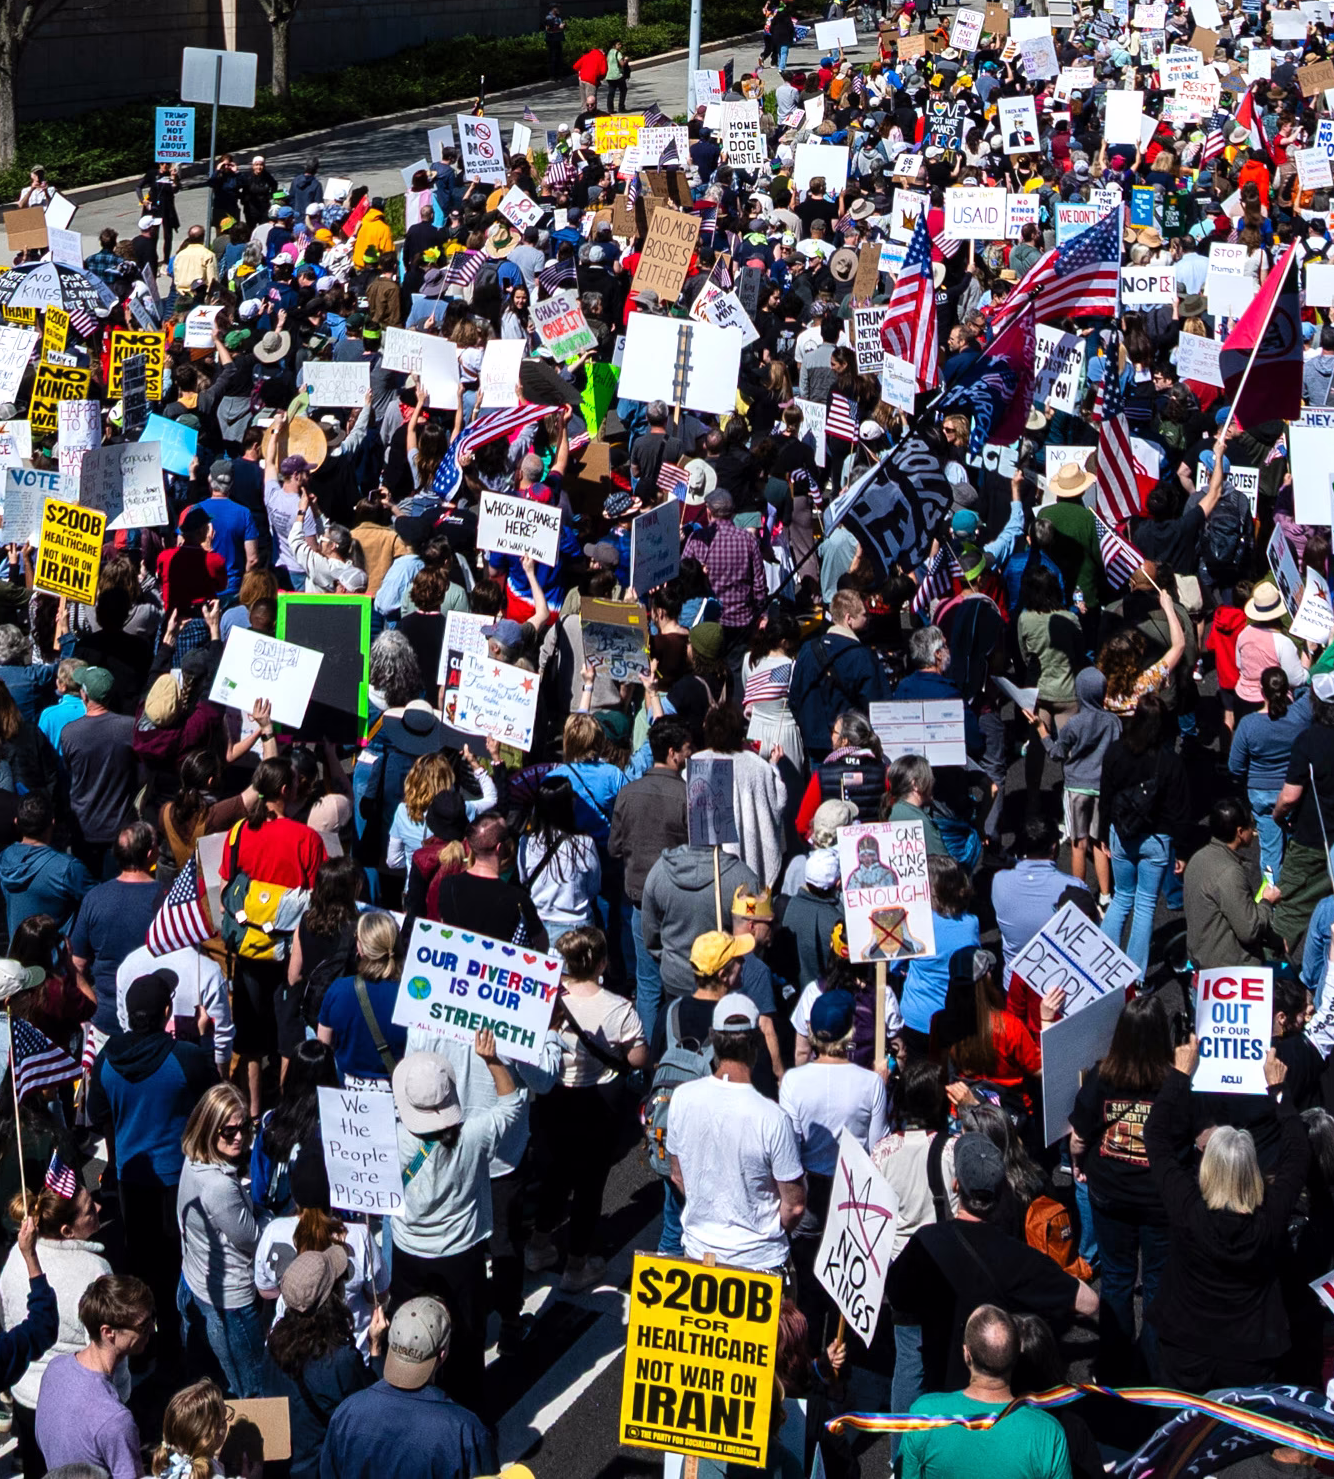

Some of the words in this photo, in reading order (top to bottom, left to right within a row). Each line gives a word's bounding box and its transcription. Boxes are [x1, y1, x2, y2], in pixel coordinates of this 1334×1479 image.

[1182, 81, 1218, 93] RESIST
[729, 121, 758, 131] HOME
[730, 132, 740, 141] OF
[743, 131, 757, 140] THE
[729, 141, 755, 153] DOG
[953, 206, 998, 226] USAID
[652, 216, 669, 235] NO
[671, 219, 696, 242] MOB
[644, 237, 691, 265] BOSSES
[636, 262, 683, 288] EITHER
[535, 298, 570, 321] CHAOS
[543, 310, 584, 341] CRUELTY
[505, 520, 537, 538] HERE?
[515, 506, 526, 520] IN
[528, 508, 559, 532] CHARGE
[892, 841, 924, 854] MAD
[895, 828, 923, 844] ONE
[889, 853, 925, 866] KING
[897, 863, 925, 878] WAS
[846, 882, 930, 909] ENOUGH!
[417, 946, 457, 973] OUR
[467, 958, 557, 1003] DIVERSITY
[449, 977, 468, 996] IS
[477, 982, 521, 1011] OUR
[430, 1002, 535, 1049] STRENGTH
[342, 1095, 369, 1114] We
[340, 1119, 370, 1138] the
[329, 1143, 388, 1165] People
[351, 1169, 380, 1184] are
[334, 1184, 401, 1209] PISSED
[638, 1267, 775, 1323] $200B
[680, 1315, 729, 1334] FOR
[638, 1325, 769, 1367] HEALTHCARE
[637, 1358, 673, 1382] NOT
[680, 1365, 725, 1391] WAR
[730, 1374, 757, 1396] ON
[631, 1383, 755, 1441] IRAN!
[641, 1429, 656, 1439] THE
[657, 1431, 671, 1442] PARTY
[672, 1434, 684, 1444] FOR
[686, 1435, 715, 1450] SOCIALISM
[724, 1443, 757, 1459] LIBERATION
